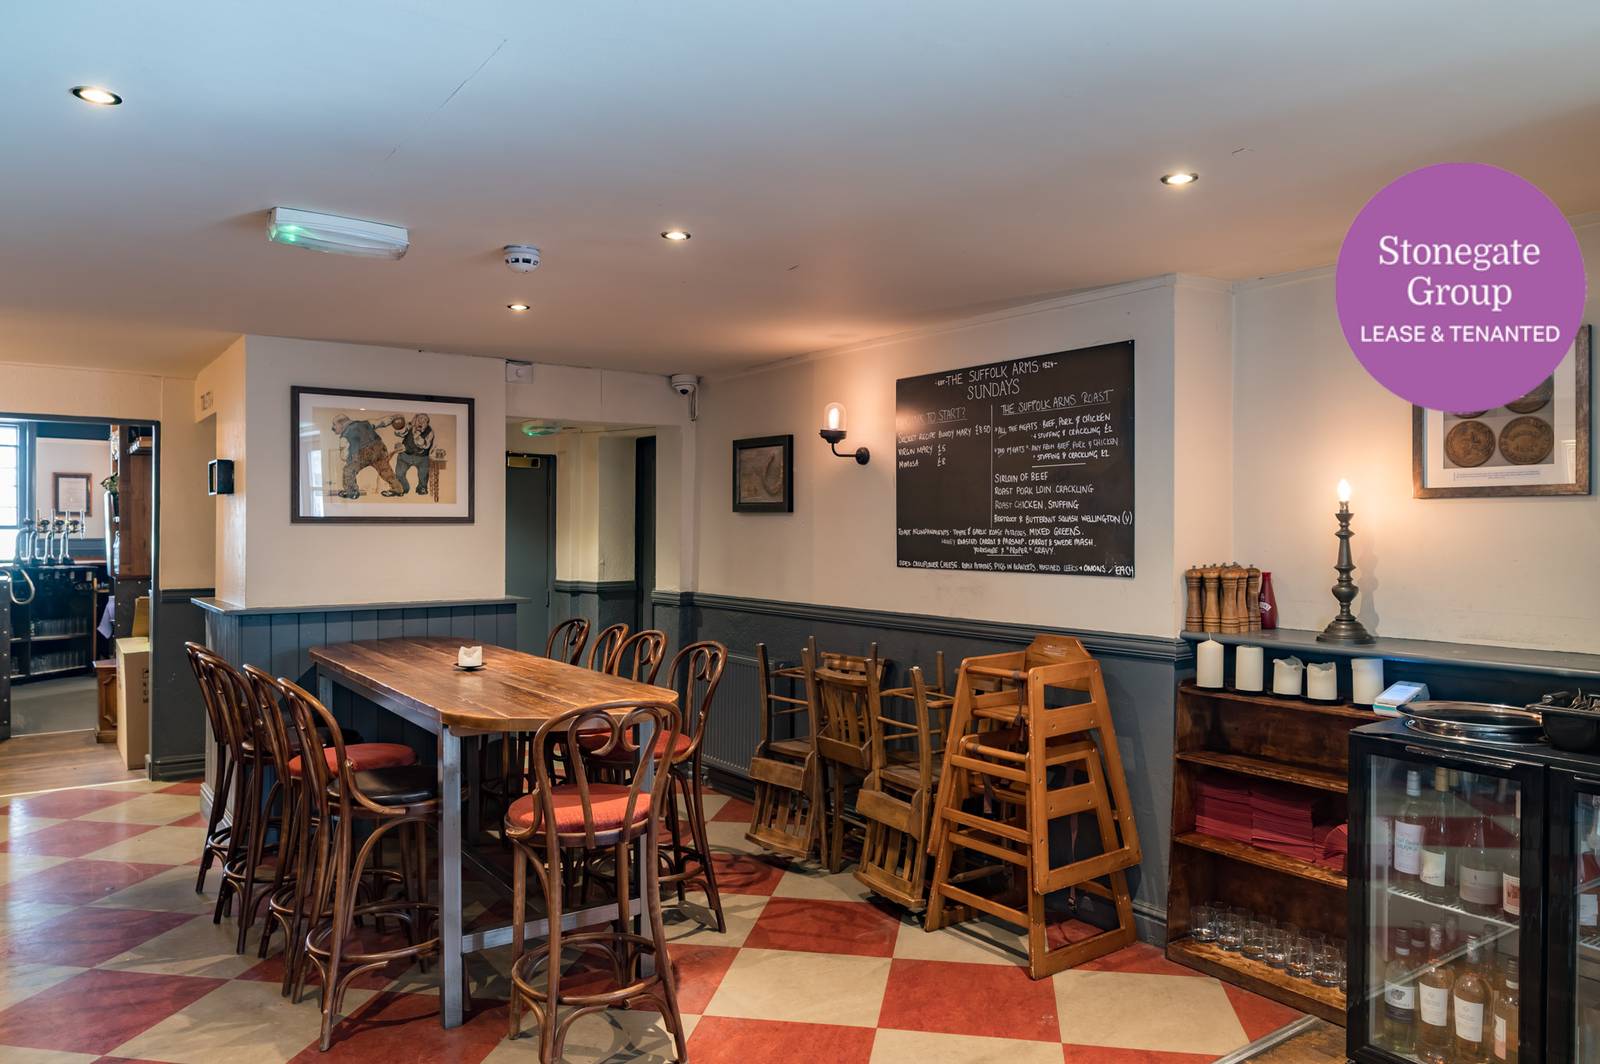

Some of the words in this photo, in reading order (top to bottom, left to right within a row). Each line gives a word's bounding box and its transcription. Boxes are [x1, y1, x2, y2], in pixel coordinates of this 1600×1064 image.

[946, 373, 963, 385] THE
[969, 365, 1008, 382] SUFFOLK
[1012, 360, 1039, 375] ARMS
[967, 378, 1020, 400] SUNDAYS
[1000, 403, 1014, 415] THE
[1018, 400, 1051, 413] SUFFOLK
[1052, 394, 1077, 408] ARMS
[1081, 389, 1114, 404] ROAST
[1082, 413, 1111, 423] CHICKEN
[1020, 472, 1028, 481] OF
[1031, 471, 1048, 481] BEEF
[994, 487, 1013, 495] ROAST
[1016, 486, 1033, 495] PORK
[1055, 483, 1095, 494] CRACKLING
[995, 500, 1012, 509] ROAST
[1048, 500, 1080, 509] STUFFING
[1081, 514, 1120, 524] WELLINGTON
[1028, 527, 1051, 536] MIXED
